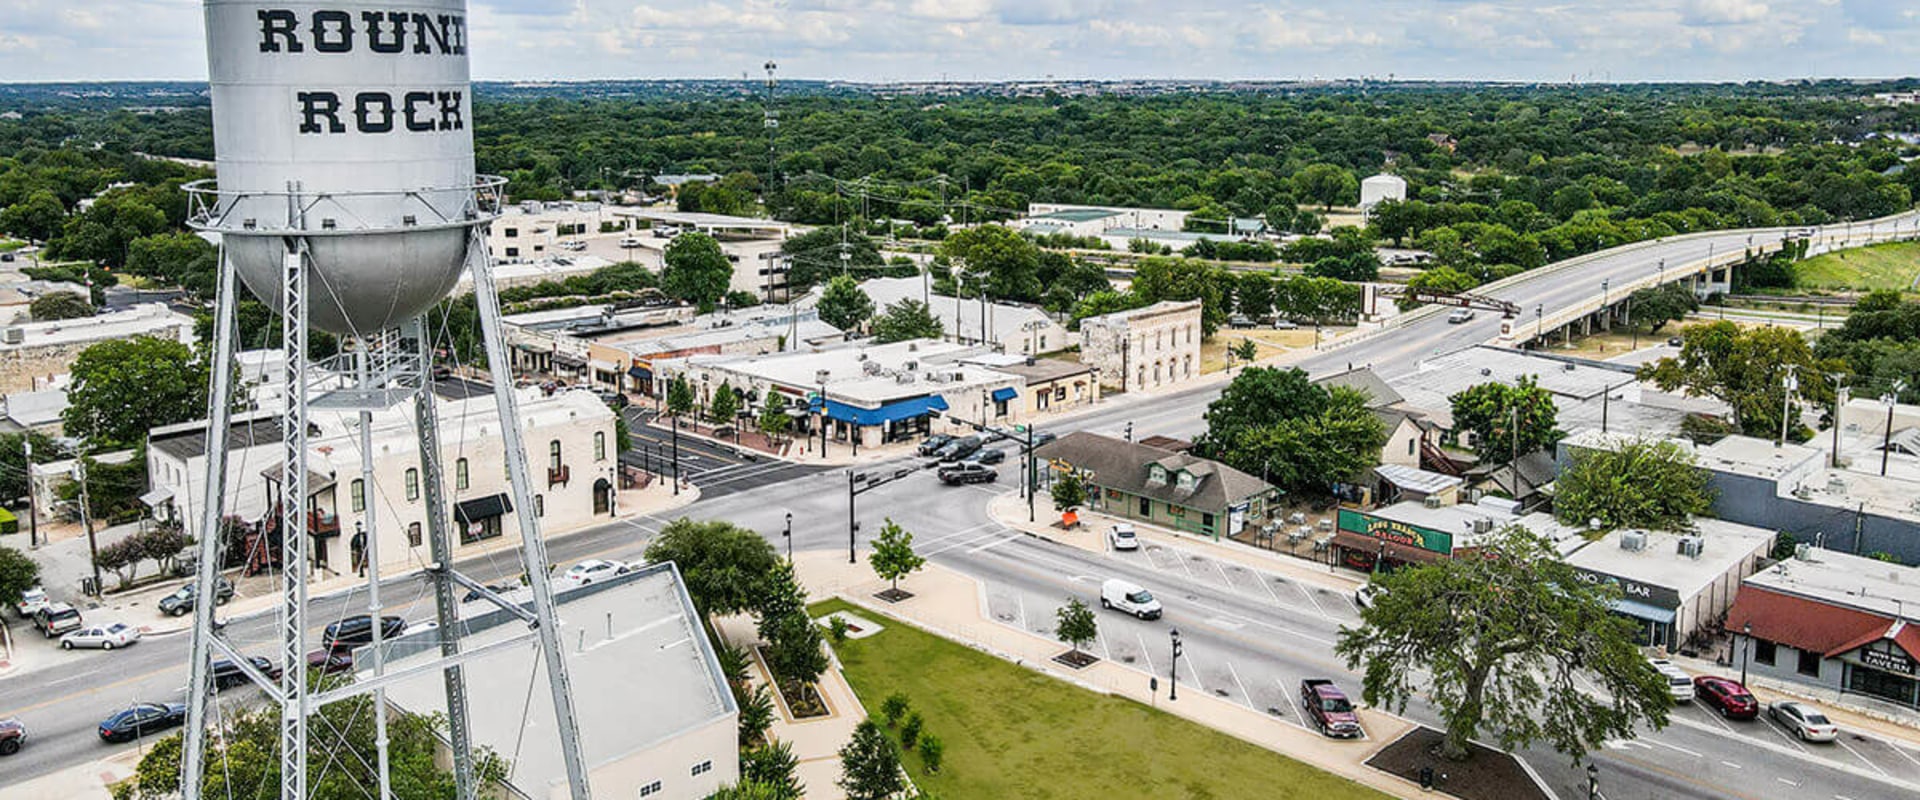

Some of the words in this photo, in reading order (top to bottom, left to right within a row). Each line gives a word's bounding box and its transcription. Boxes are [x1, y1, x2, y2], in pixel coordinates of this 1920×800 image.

[297, 91, 463, 134] ROCK
[1626, 583, 1650, 598] BAR
[1865, 655, 1911, 674] TAVERN
